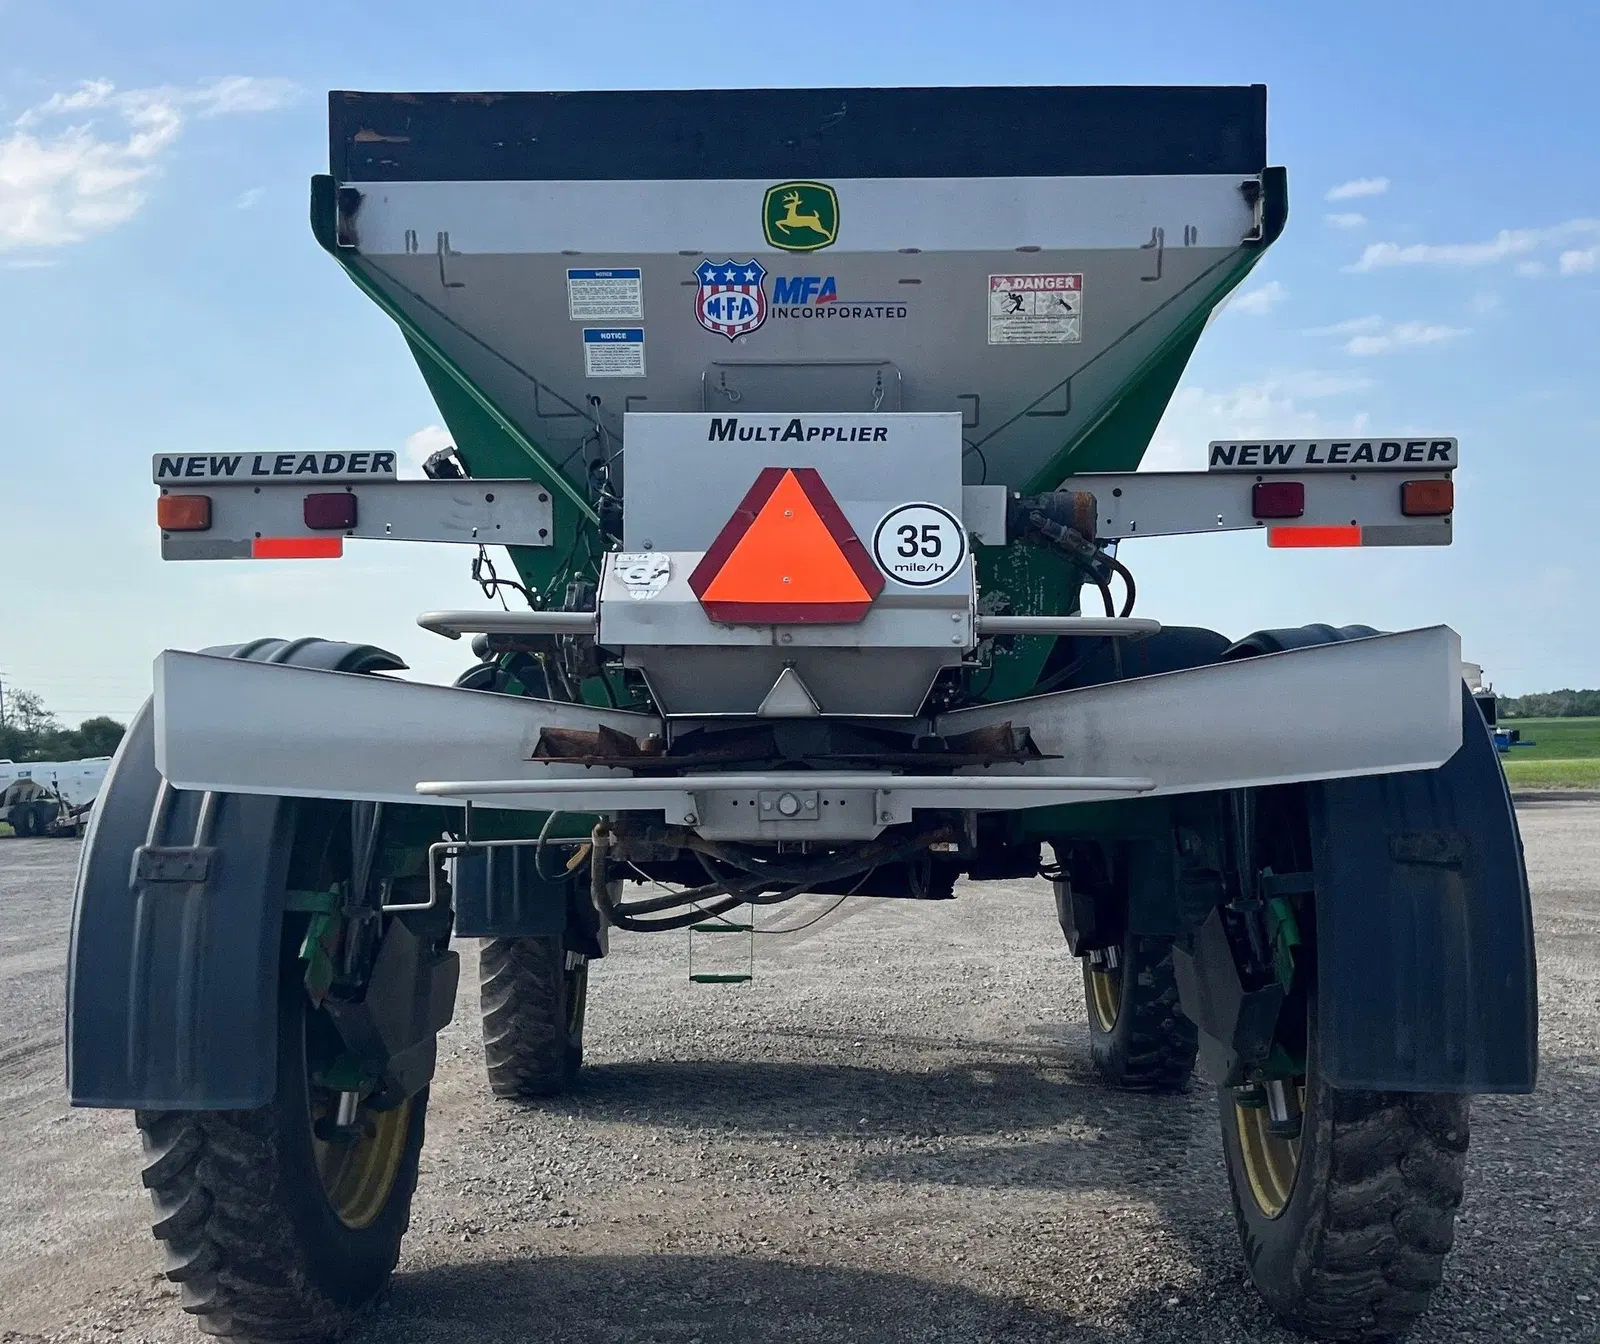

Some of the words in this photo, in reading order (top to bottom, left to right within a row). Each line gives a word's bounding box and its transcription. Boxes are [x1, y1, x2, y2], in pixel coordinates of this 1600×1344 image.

[772, 276, 837, 304] MFA
[1013, 277, 1075, 289] DANGER
[771, 307, 907, 318] INCORPORATED
[157, 455, 243, 477] NEW
[251, 453, 395, 476] LEADER
[1210, 444, 1296, 466] NEW
[1305, 441, 1452, 464] LEADER
[897, 525, 942, 558] 35
[895, 563, 944, 572] mile/h
